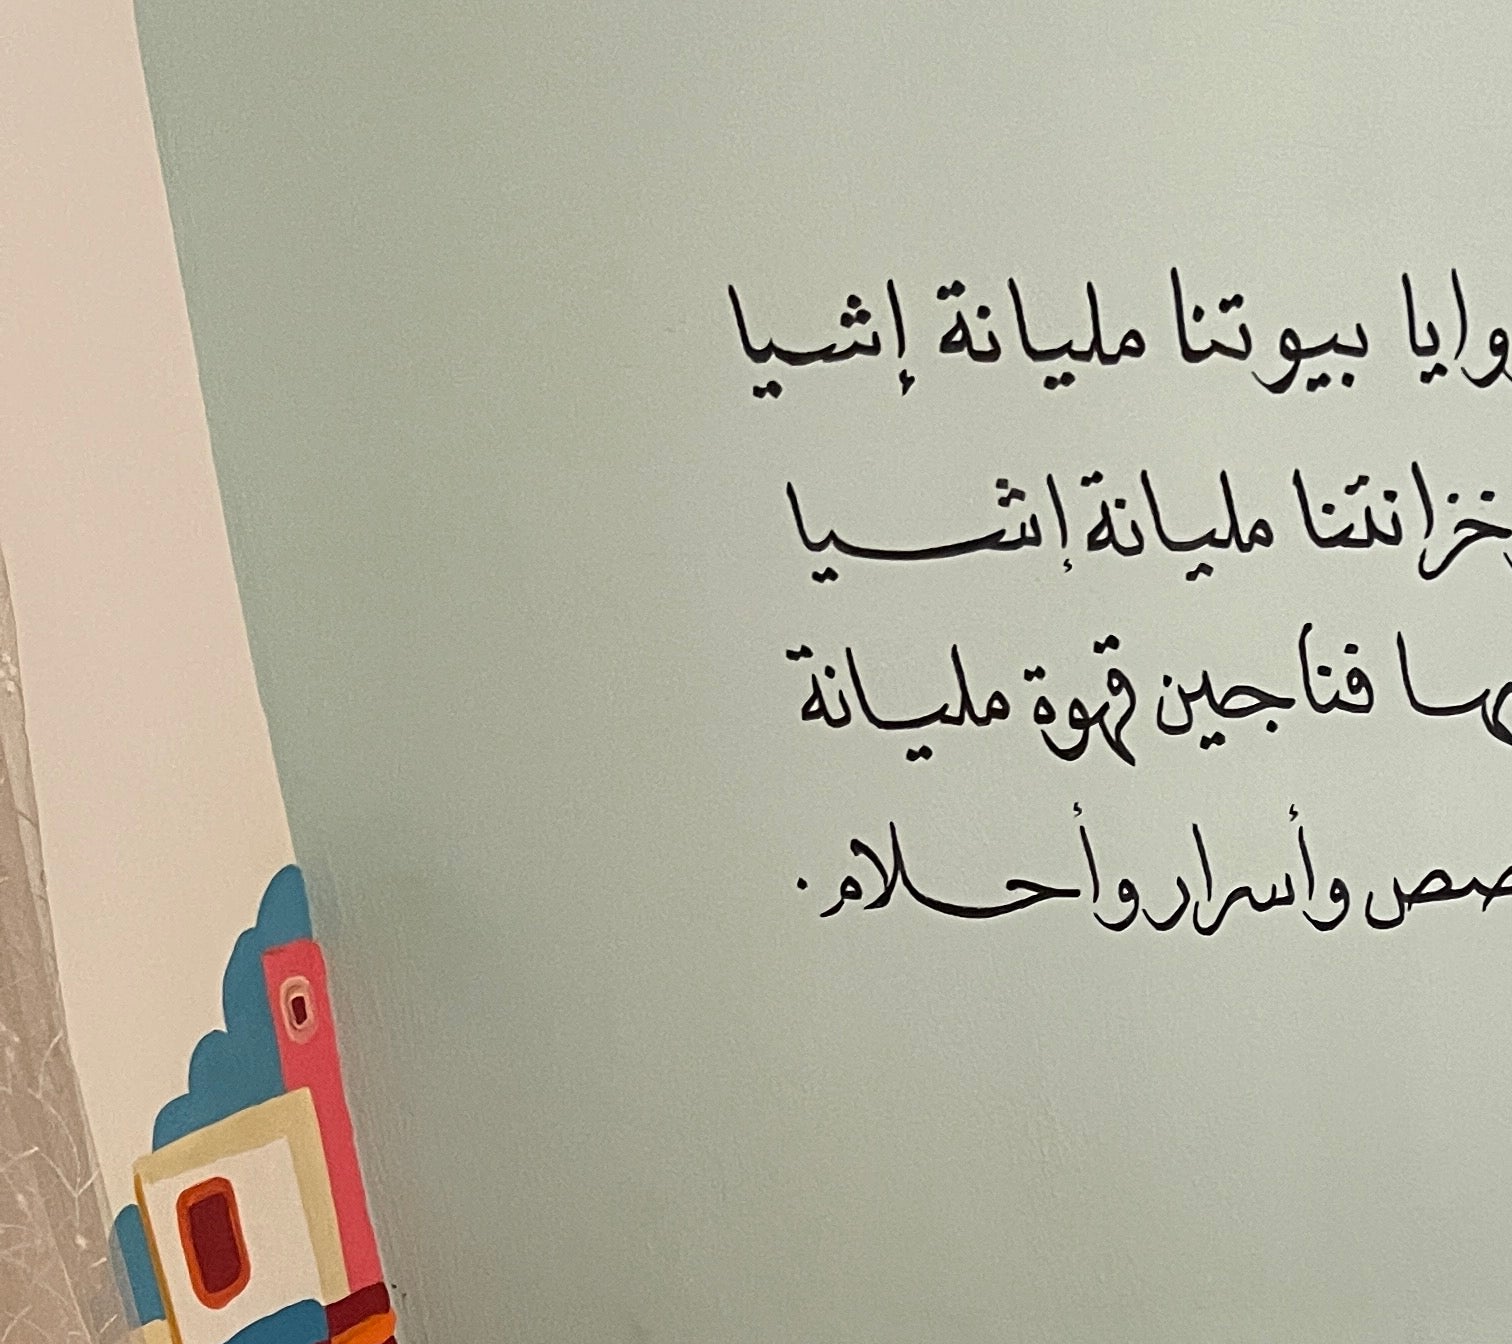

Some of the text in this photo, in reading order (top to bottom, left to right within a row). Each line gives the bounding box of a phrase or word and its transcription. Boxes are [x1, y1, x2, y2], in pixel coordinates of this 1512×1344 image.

[727, 277, 917, 400] إشيا
[935, 276, 1147, 391] مليانة
[1169, 265, 1369, 395] بيوتنا
[785, 472, 1074, 585] إشيا
[1079, 468, 1275, 583] مليانة
[784, 642, 1012, 763] مليانة
[1022, 633, 1138, 768] قهوة
[1155, 621, 1375, 751] فناجين
[1140, 802, 1351, 938] وأسرار
